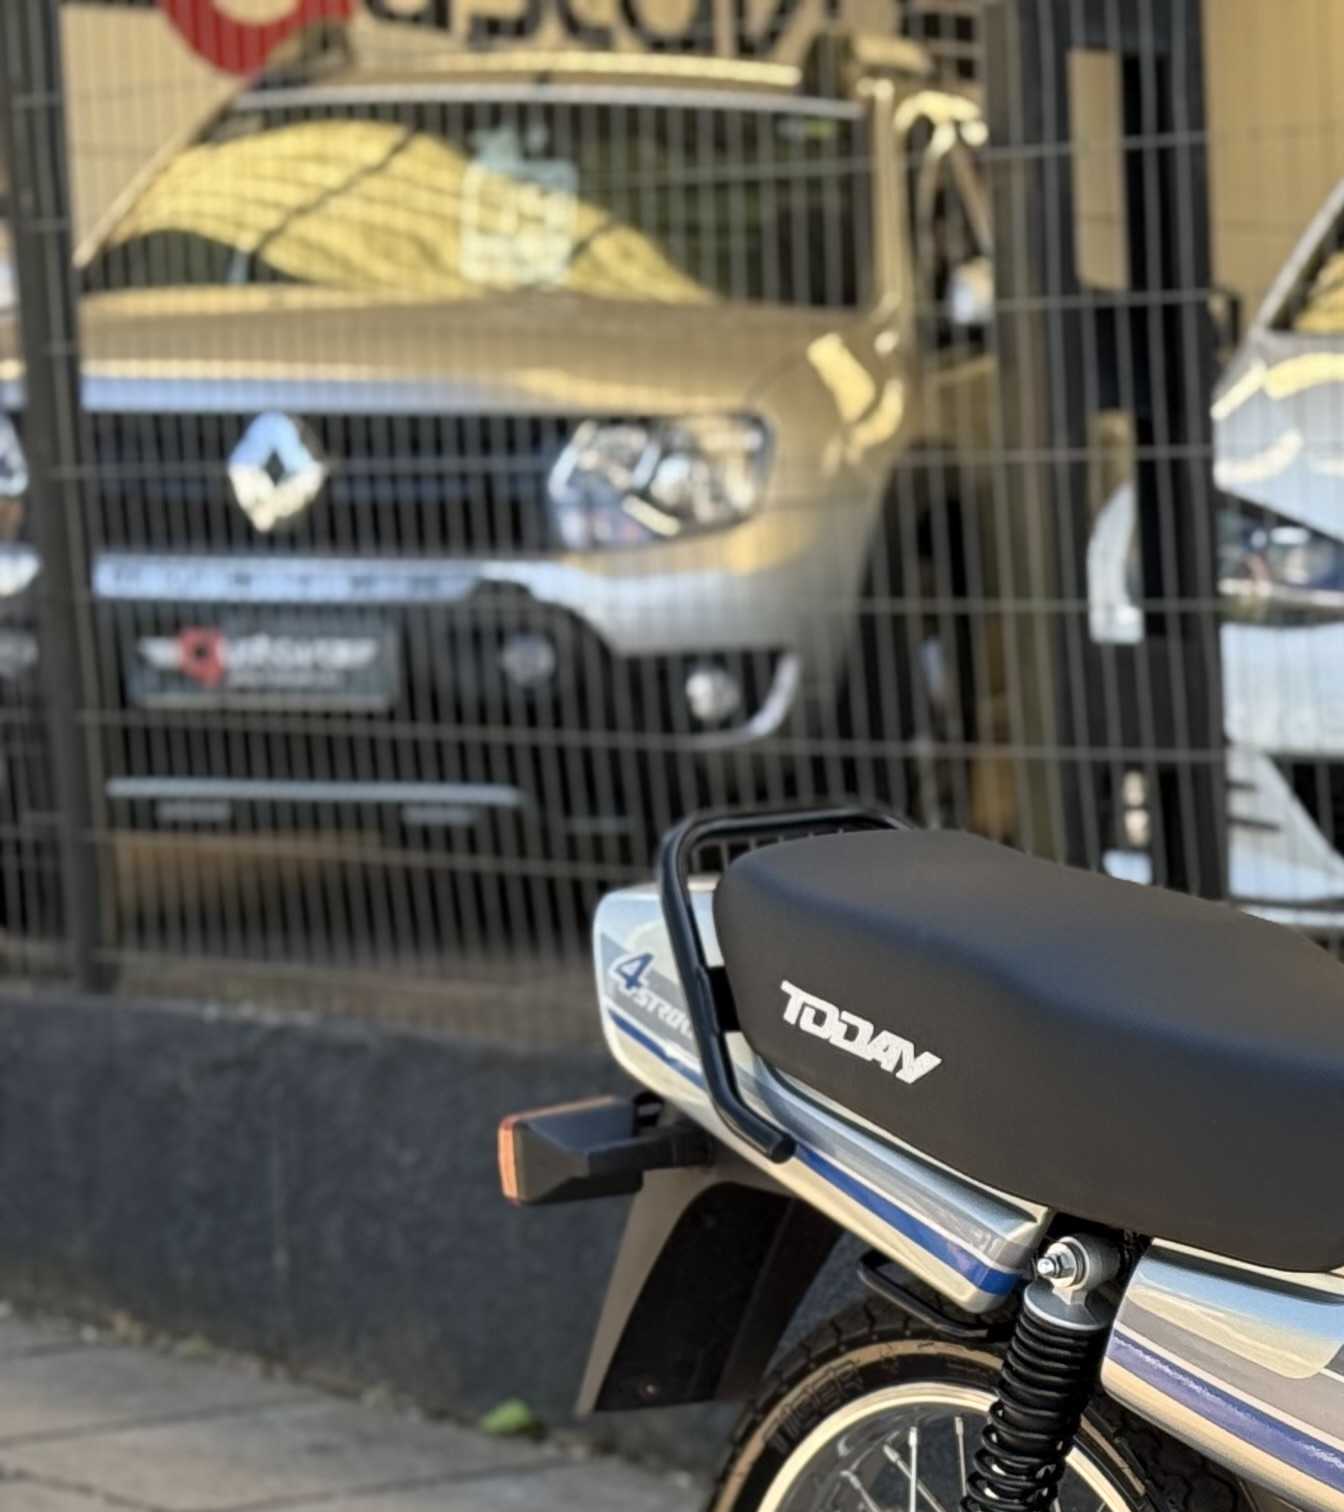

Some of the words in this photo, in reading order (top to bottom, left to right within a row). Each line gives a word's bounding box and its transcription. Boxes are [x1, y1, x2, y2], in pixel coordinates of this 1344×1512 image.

[610, 950, 655, 994] 4
[633, 987, 695, 1040] STRO
[780, 980, 943, 1085] TODAY
